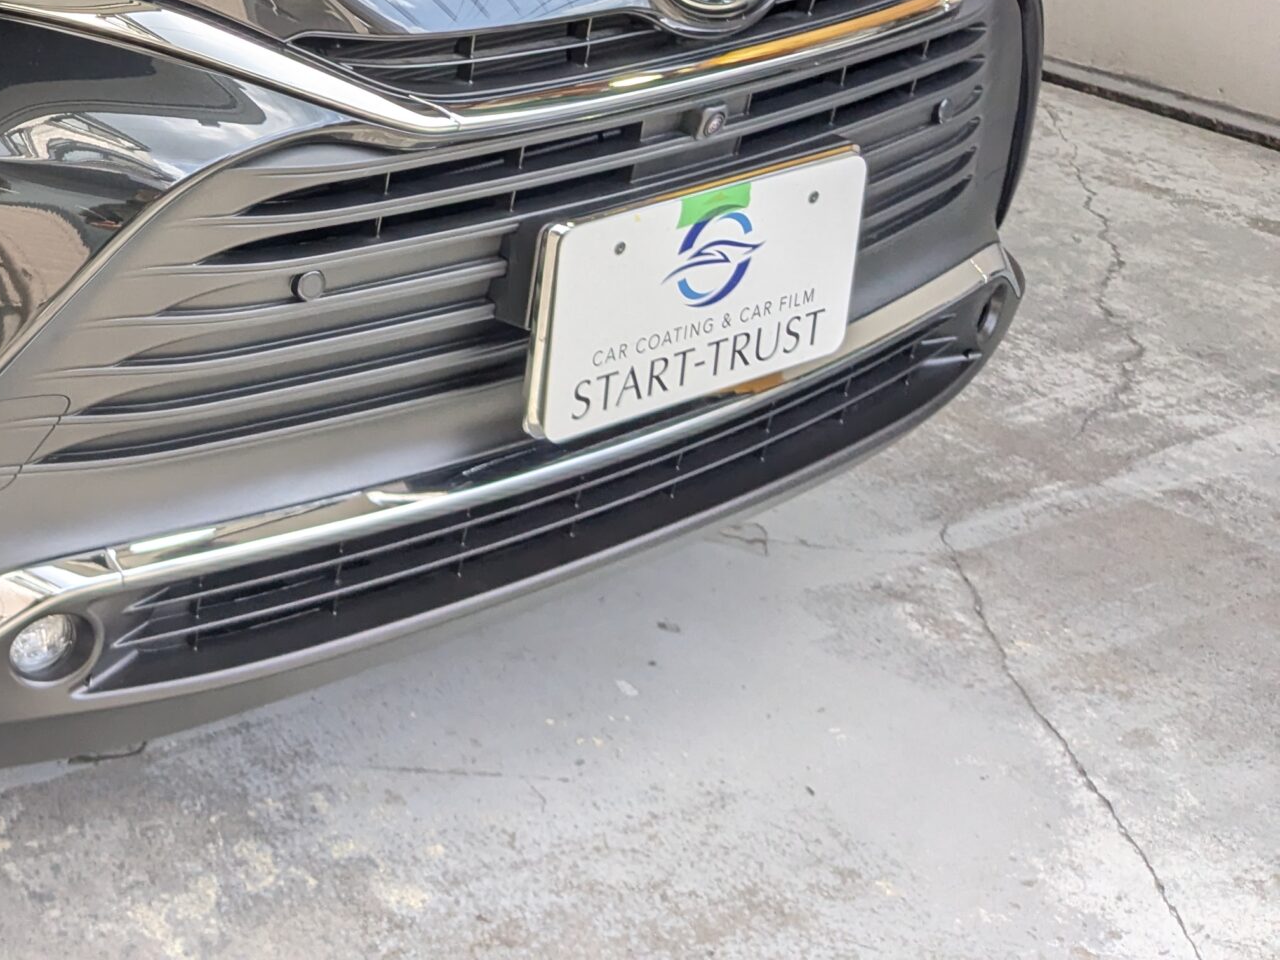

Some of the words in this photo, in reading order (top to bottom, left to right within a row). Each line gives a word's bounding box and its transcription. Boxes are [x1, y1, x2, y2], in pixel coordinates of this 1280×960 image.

[571, 308, 826, 422] START-TRUST
[592, 343, 629, 368] CAR
[635, 318, 714, 355] COATING
[720, 312, 733, 329] &
[739, 300, 773, 324] CAR
[778, 288, 816, 313] FILM
